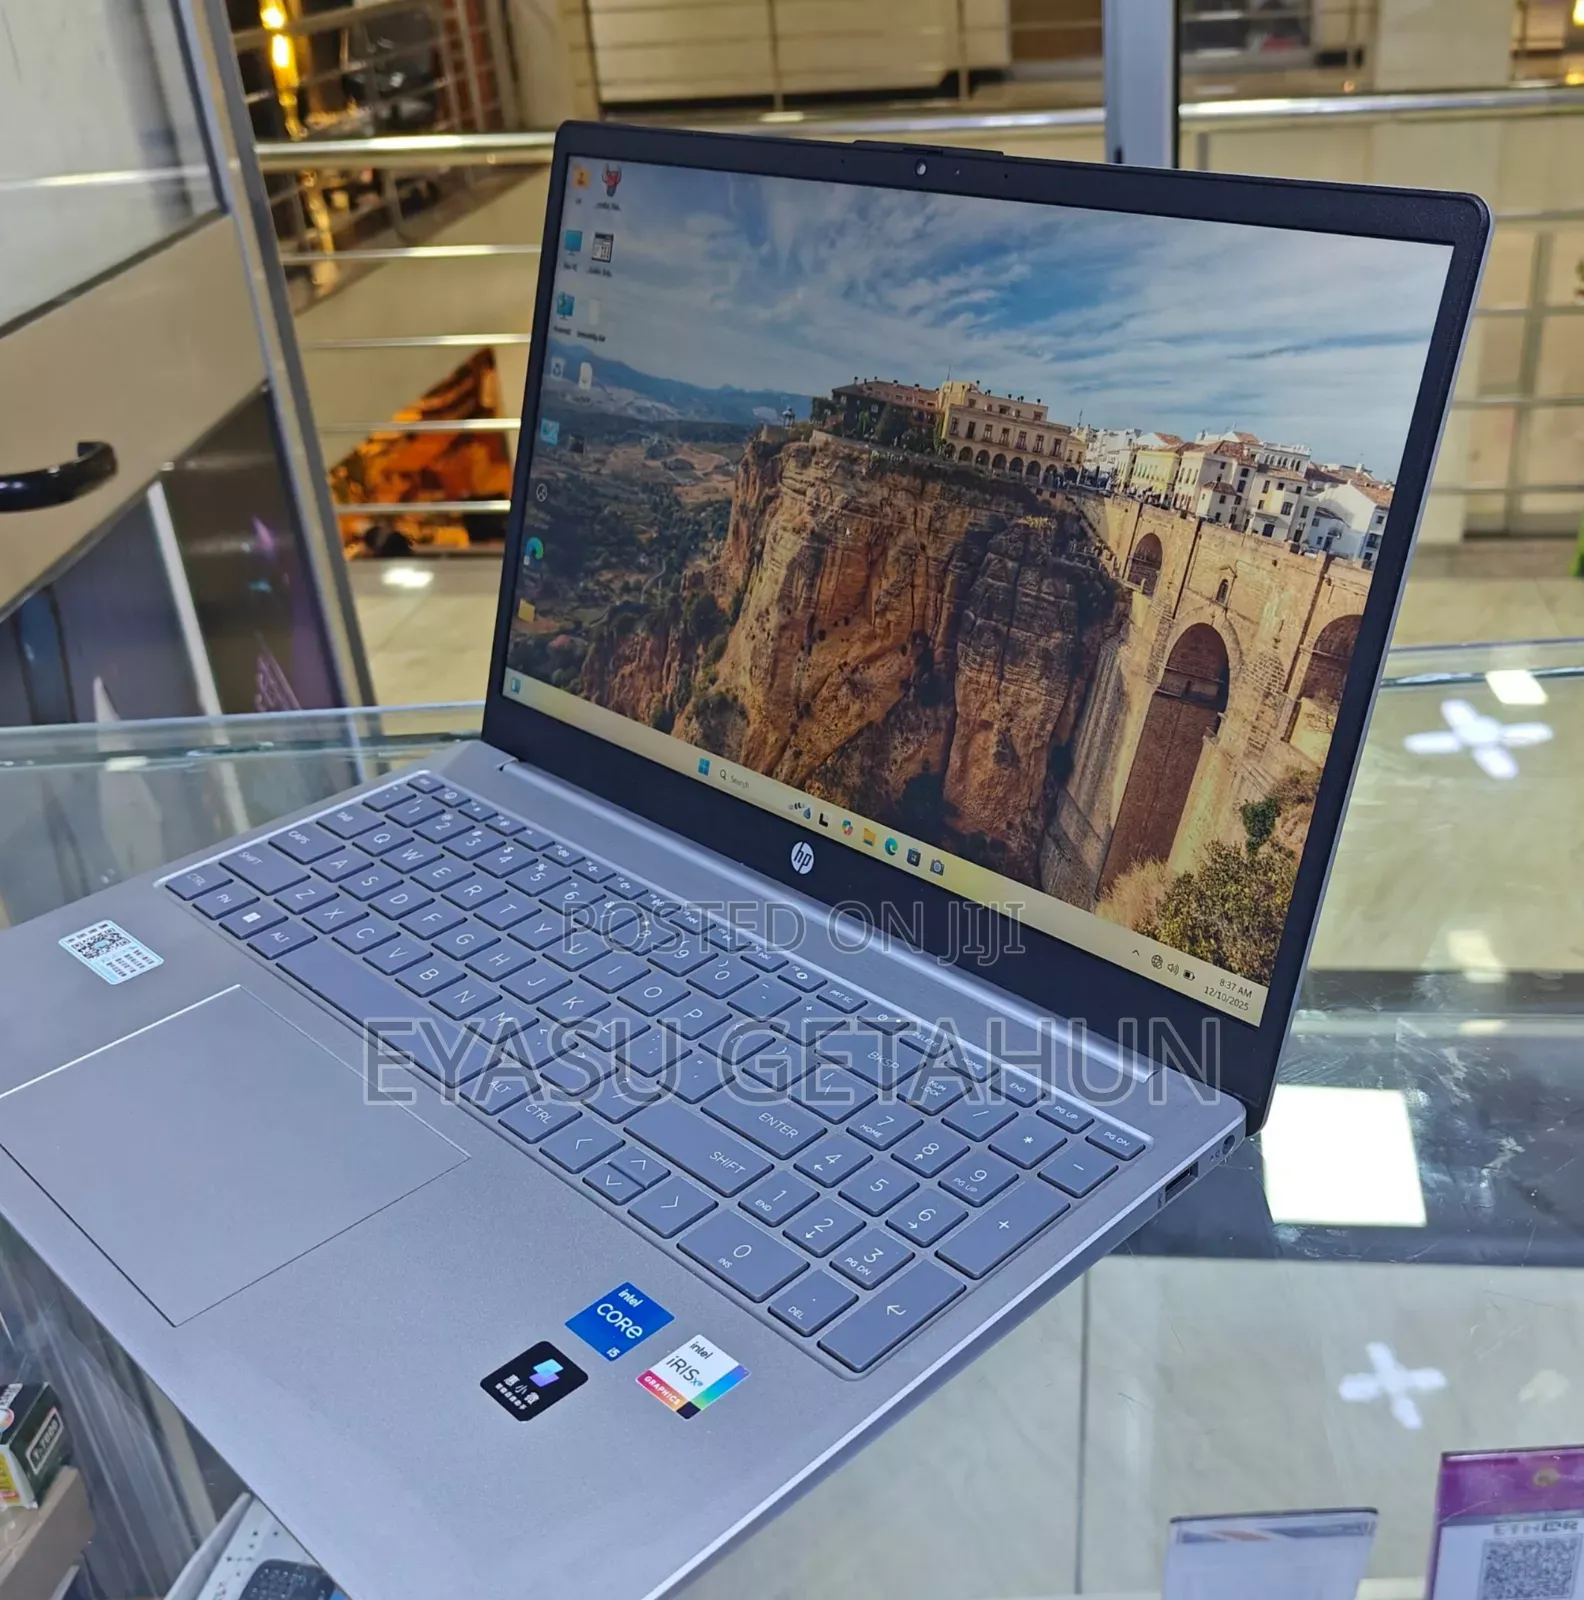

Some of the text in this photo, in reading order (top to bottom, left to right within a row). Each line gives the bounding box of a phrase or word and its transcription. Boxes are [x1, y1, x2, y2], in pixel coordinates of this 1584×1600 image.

[436, 822, 450, 831] 2
[288, 830, 310, 844] CAPS
[373, 833, 391, 844] Q
[466, 837, 482, 847] 3
[238, 852, 263, 864] SHIFT
[402, 848, 424, 860] W
[499, 855, 513, 864] 4
[792, 841, 813, 875] hp
[330, 859, 348, 870] A
[432, 866, 452, 878] E
[530, 872, 546, 882] 5
[188, 873, 206, 886] CTRL
[362, 876, 379, 886] S
[296, 889, 316, 900] Z
[464, 884, 482, 896] R
[564, 892, 580, 900] 6
[216, 894, 232, 904] FN
[390, 894, 408, 904] D
[324, 908, 345, 920] X
[500, 904, 517, 914] T
[422, 912, 442, 922] F
[356, 927, 374, 938] C
[534, 923, 552, 934] Y
[270, 932, 290, 943] ALT
[456, 933, 475, 945] G
[389, 948, 409, 958] V
[569, 943, 588, 954] U
[674, 949, 690, 959] 9
[489, 953, 511, 966] H
[419, 968, 439, 980] B
[714, 970, 730, 980] 0
[528, 978, 546, 986] J
[1219, 978, 1252, 998] 8:37 AM
[454, 990, 476, 1004] N
[644, 986, 662, 998] O
[562, 996, 584, 1010] K
[1204, 986, 1250, 1012] 12/10/2025
[490, 1012, 514, 1026] M
[684, 1008, 702, 1018] P
[601, 1020, 616, 1033] L
[912, 1031, 940, 1047] DELETE
[868, 1051, 900, 1069] BKSP
[964, 1056, 984, 1071] HOME
[490, 1080, 511, 1094] ALT
[920, 1084, 941, 1098] LOCK
[928, 1080, 948, 1092] NUM
[1010, 1082, 1026, 1094] END
[525, 1104, 552, 1124] CTRL
[1055, 1105, 1079, 1120] PG UP
[758, 1112, 798, 1138] ENTER
[876, 1115, 894, 1127] 7
[860, 1124, 884, 1138] HOME
[1104, 1130, 1130, 1147] PG DN
[922, 1142, 940, 1156] 8
[710, 1151, 746, 1174] SHIFT
[824, 1154, 842, 1164] 4
[970, 1169, 988, 1182] 9
[870, 1178, 890, 1192] 5
[953, 1177, 978, 1193] PG UP
[772, 1190, 788, 1202] 1
[754, 1199, 772, 1212] END
[918, 1208, 936, 1222] 6
[814, 1218, 834, 1232] 2
[733, 1244, 752, 1258] 0
[864, 1248, 884, 1263] 3
[718, 1257, 733, 1268] INS
[844, 1257, 872, 1276] PG DN
[618, 1288, 644, 1308] intel
[788, 1306, 804, 1320] DEL
[606, 1346, 621, 1359] i5
[689, 1340, 714, 1360] intel
[644, 1374, 682, 1406] GRAPHICS
